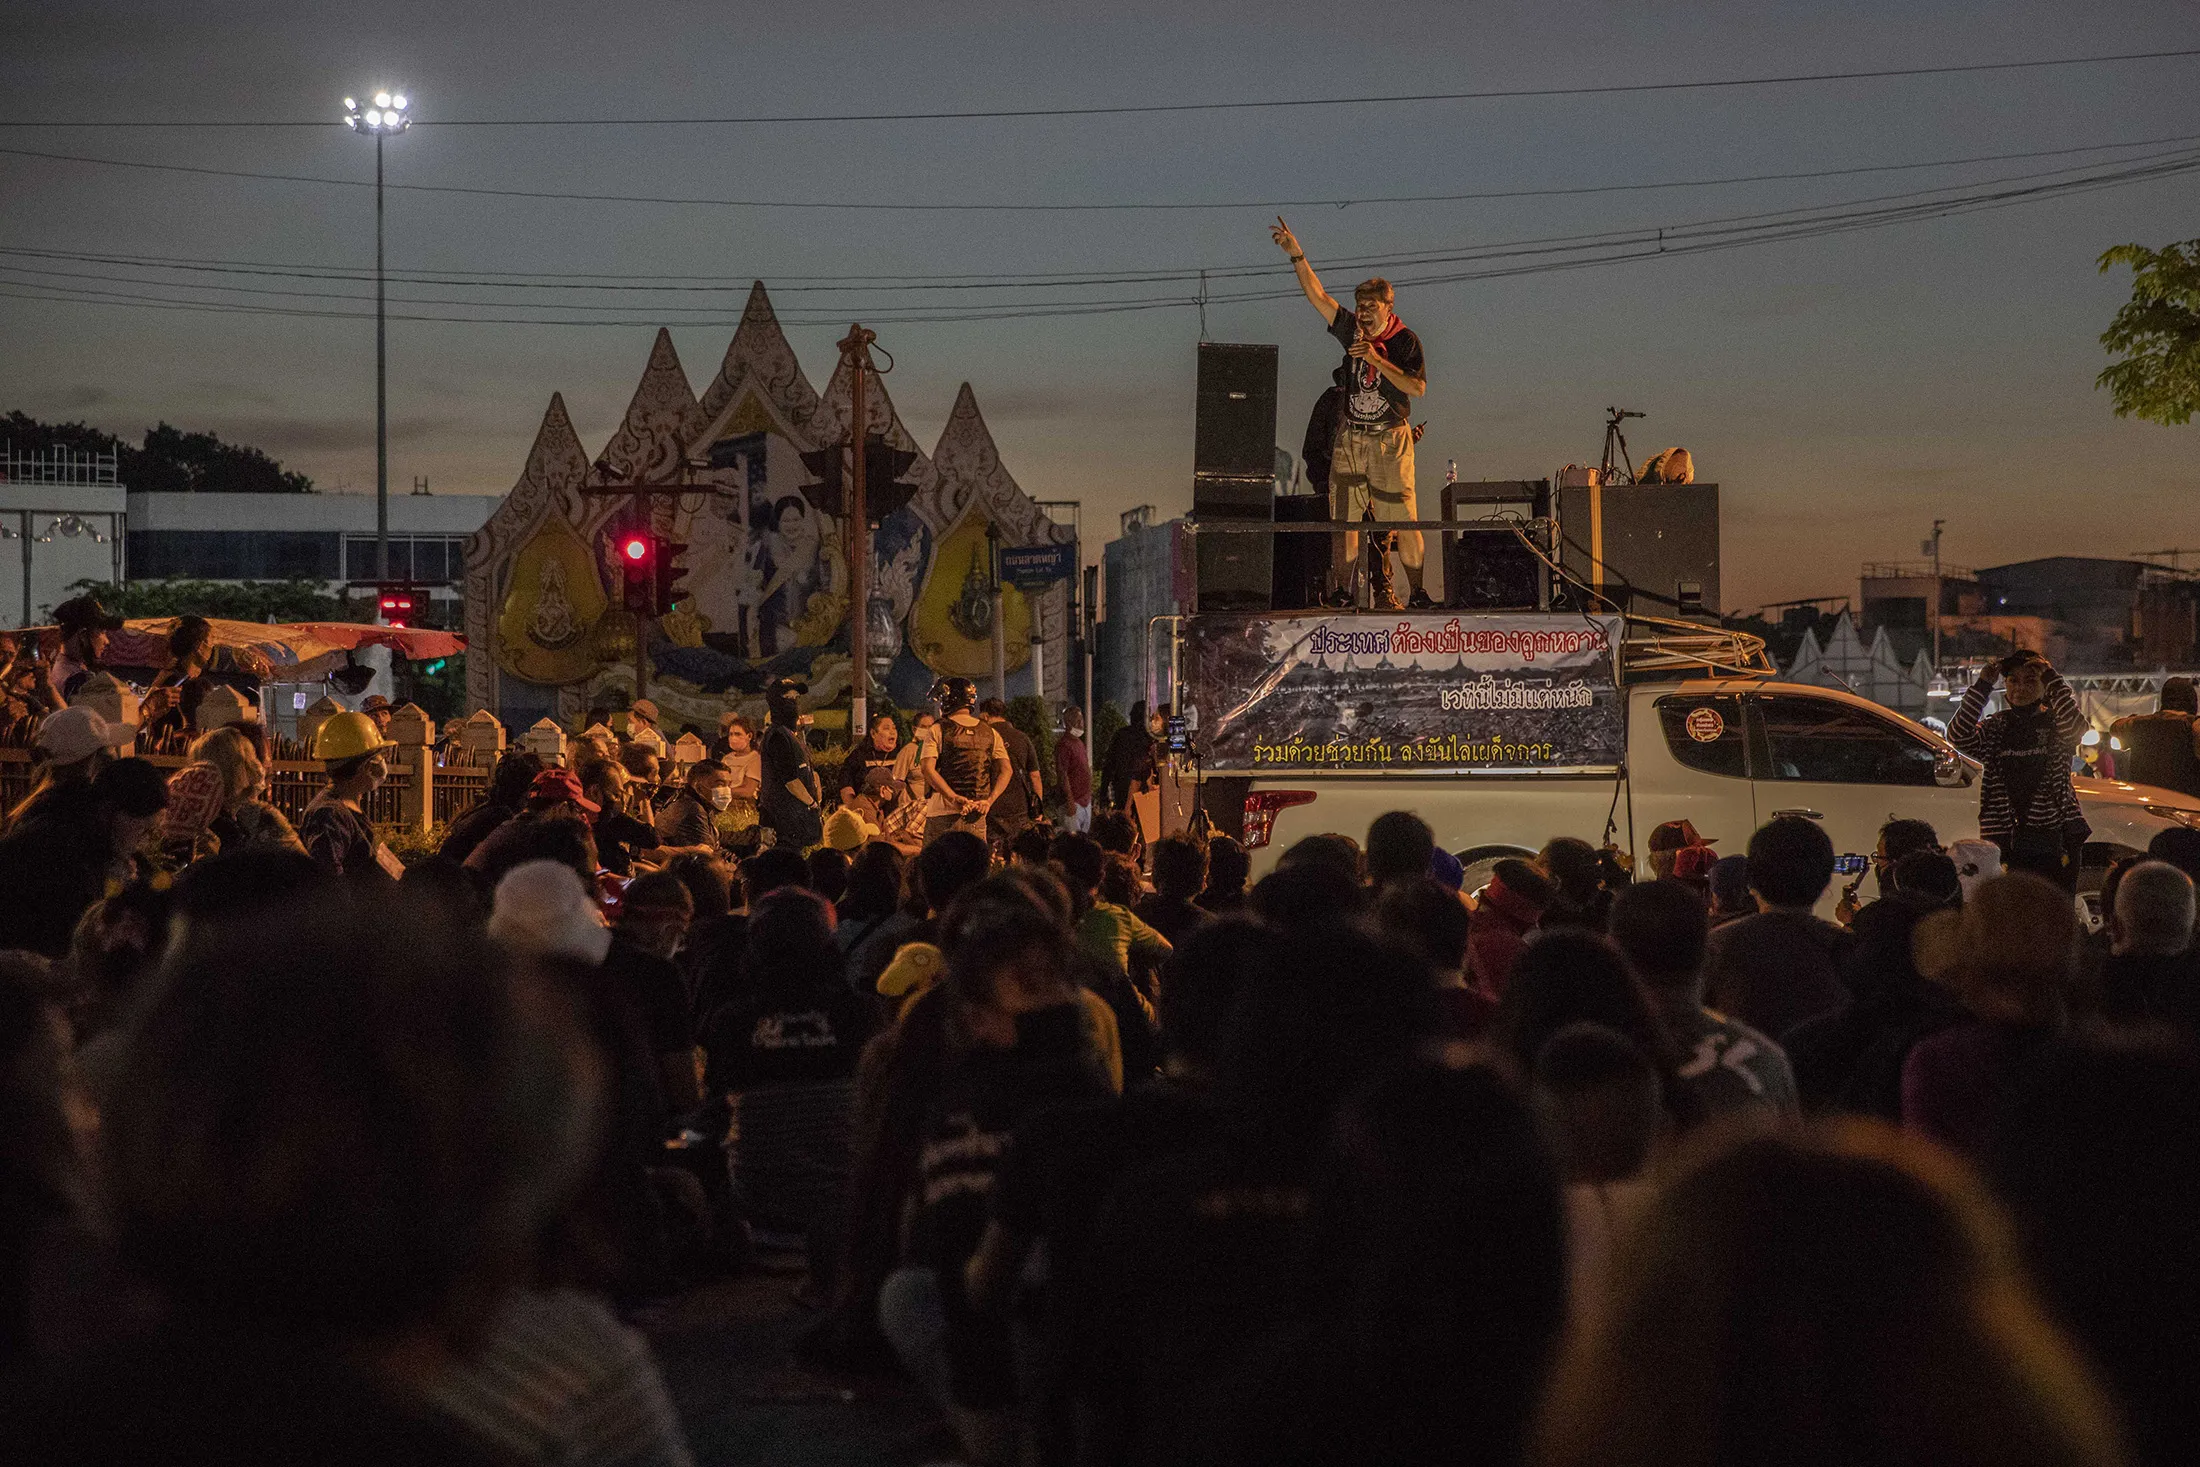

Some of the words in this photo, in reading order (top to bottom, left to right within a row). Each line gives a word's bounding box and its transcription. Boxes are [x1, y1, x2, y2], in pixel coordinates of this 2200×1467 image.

[1310, 625, 1389, 654] ประเทศ
[1391, 618, 1608, 661] ต้องเป็นของลูกหลาน
[1441, 675, 1593, 710] เวทีนี้ไม่มีแต่หนัก
[1253, 734, 1392, 762] ร่วมด้วยช่วยกัน
[1400, 733, 1553, 762] ลงขันไล่เผด็จการ
